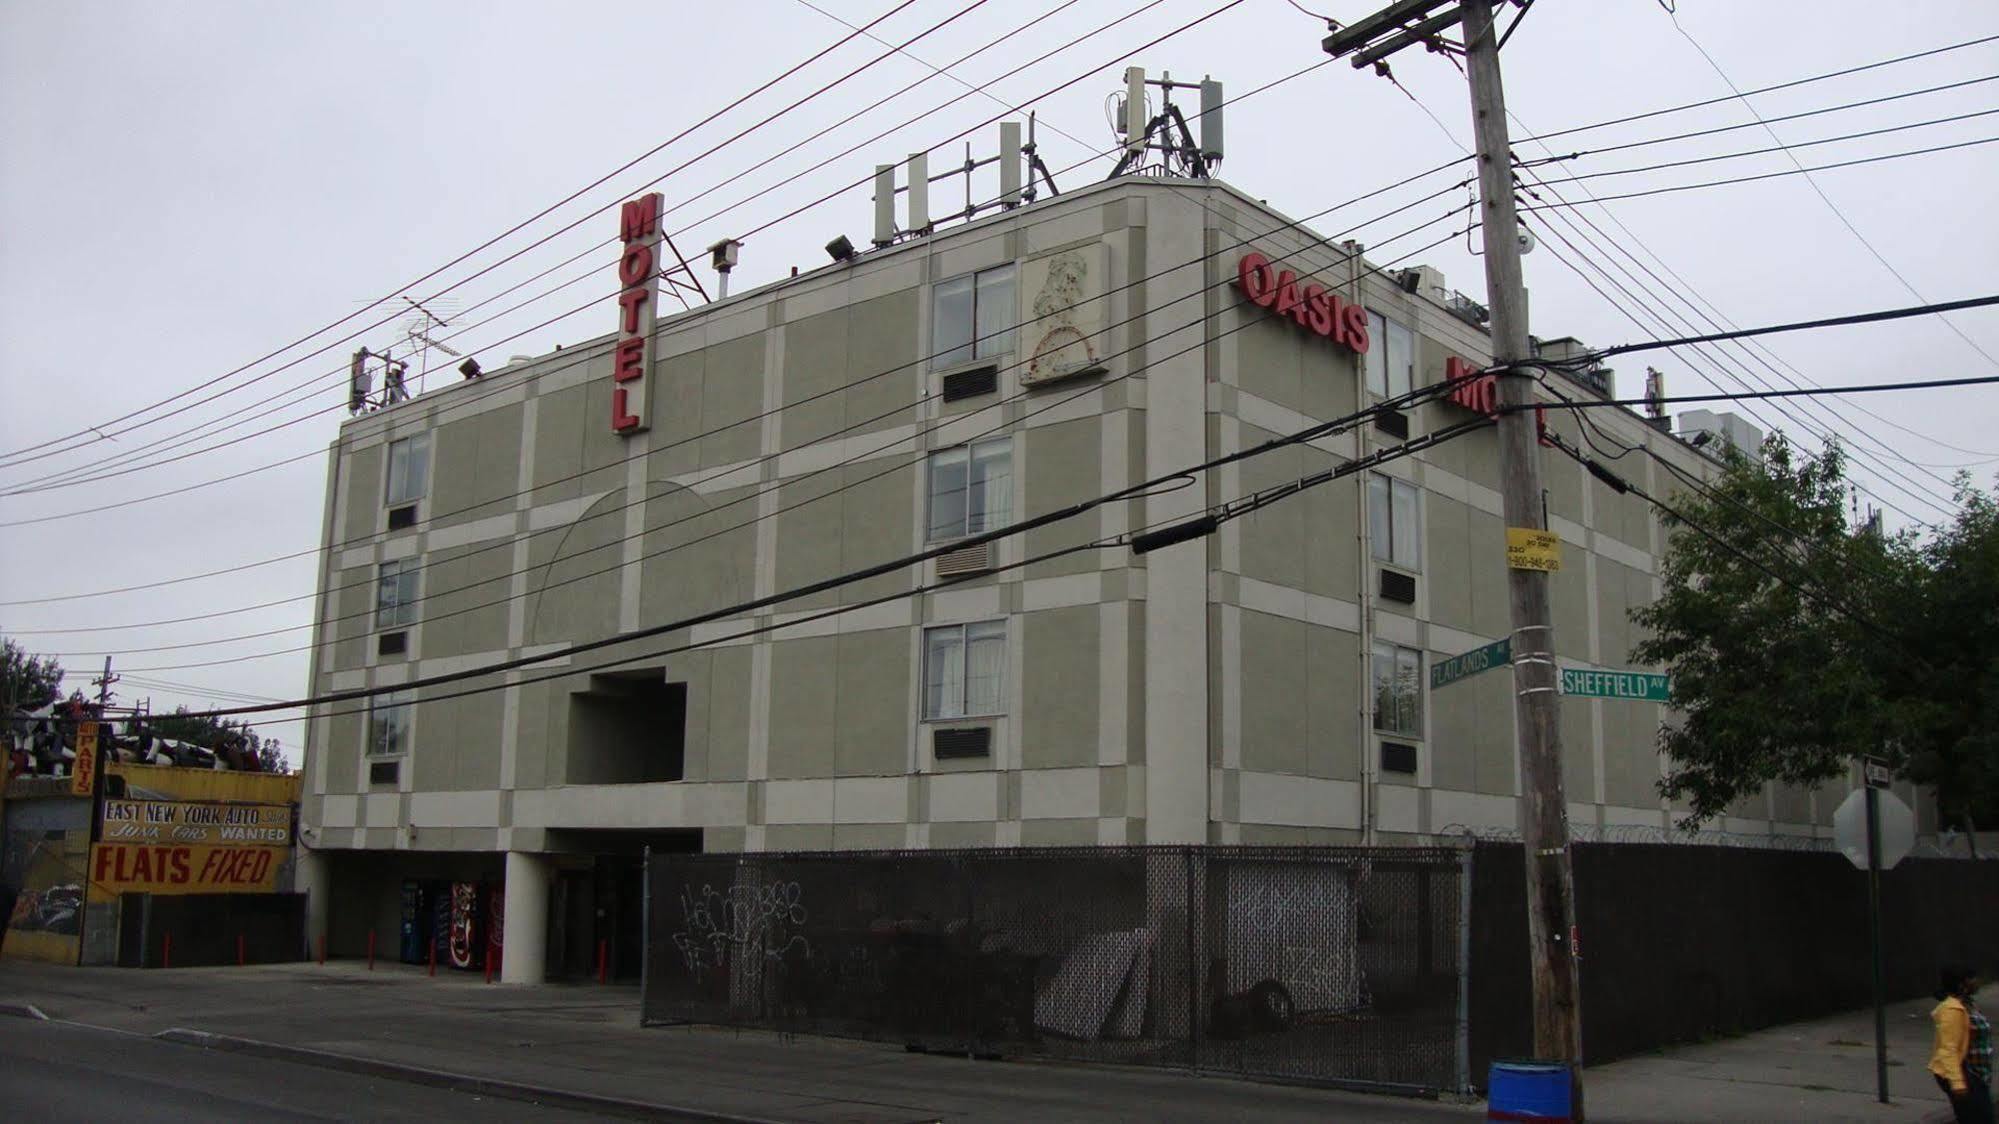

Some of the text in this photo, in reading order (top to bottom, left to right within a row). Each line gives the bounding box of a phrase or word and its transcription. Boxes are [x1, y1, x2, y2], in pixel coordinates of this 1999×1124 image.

[612, 192, 658, 431] MOTEL
[1239, 251, 1370, 354] OASIS
[1447, 356, 1557, 448] MOL
[1432, 647, 1489, 687] FLATLANDS
[1564, 669, 1665, 697] SHEFFIELD AV
[77, 736, 94, 792] PARTS
[105, 801, 140, 822] EAST
[144, 803, 177, 824] NEW
[183, 805, 221, 825] YORK
[224, 807, 259, 826] AUTO
[220, 827, 287, 841] WANTED
[94, 846, 272, 884] FLATS FIXED
